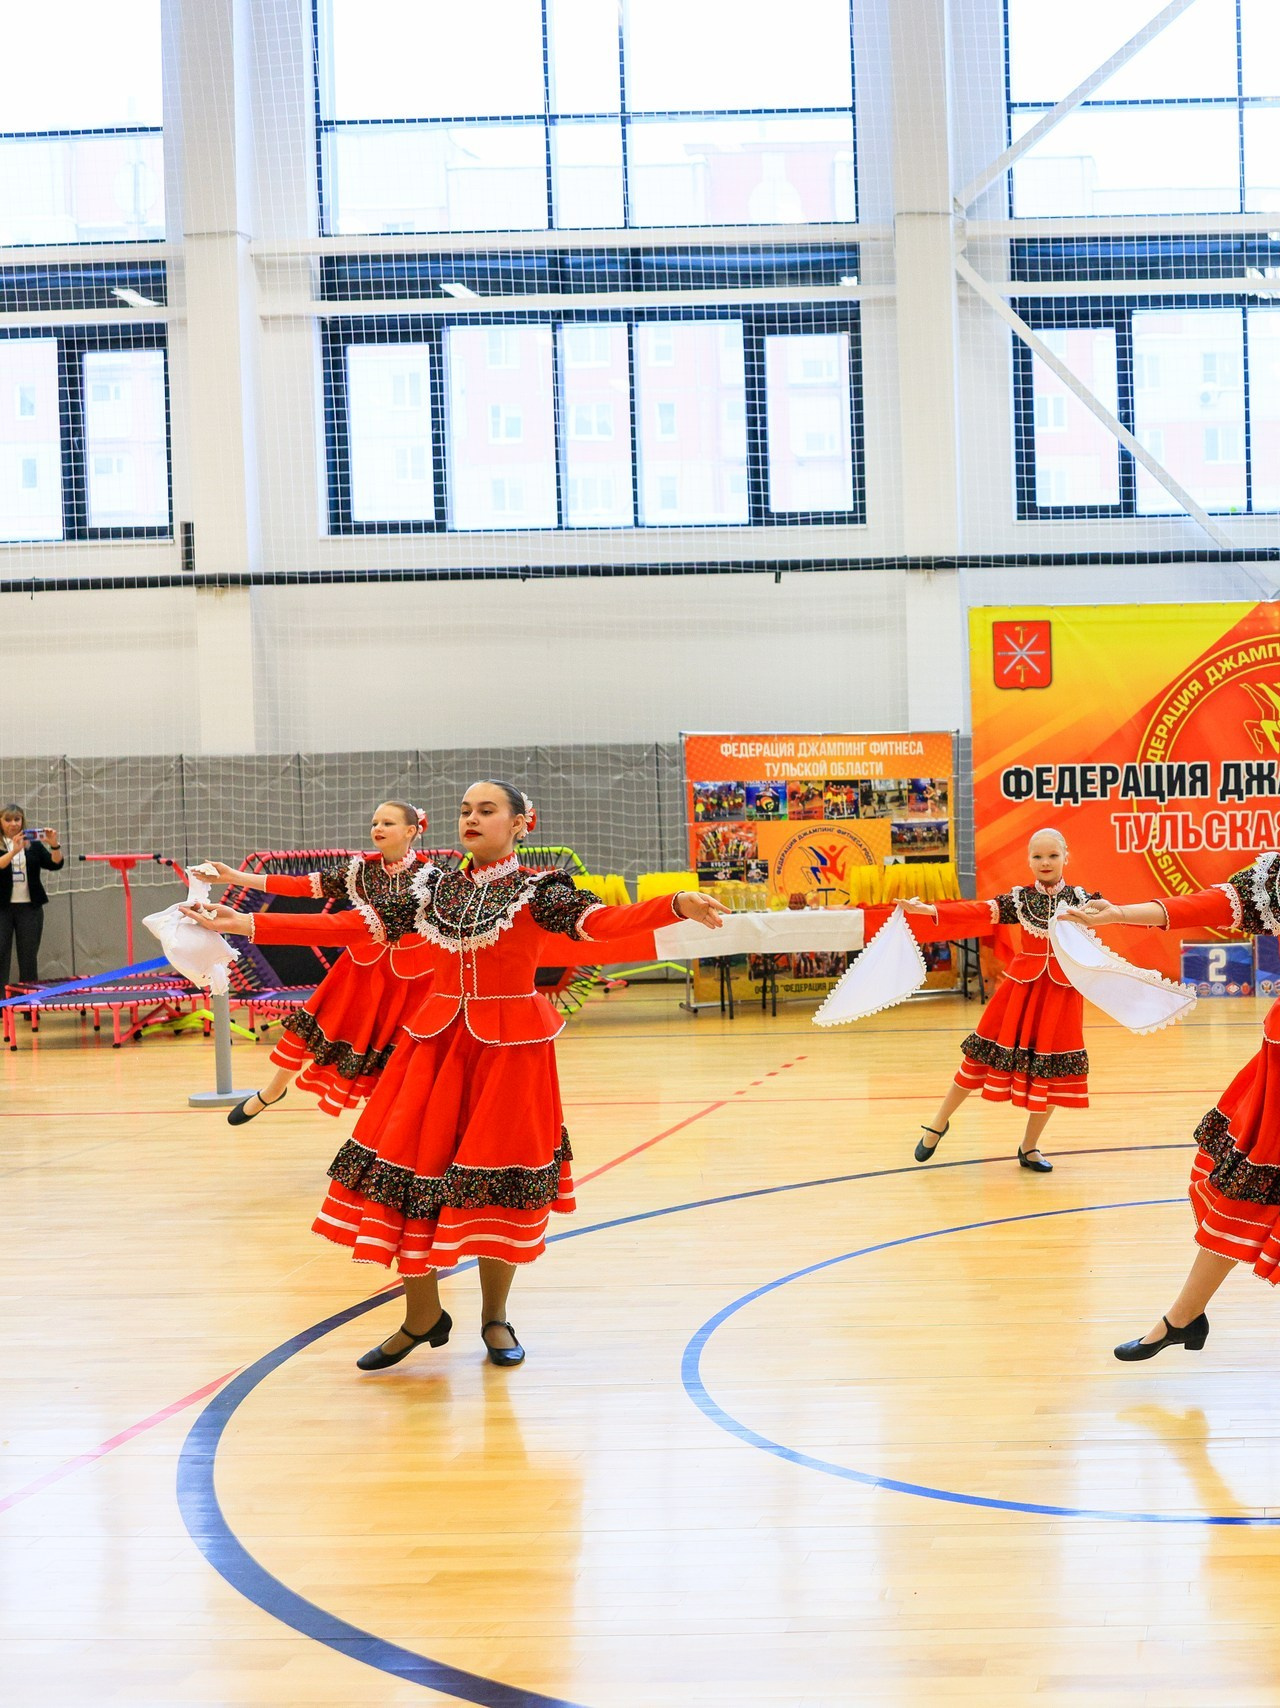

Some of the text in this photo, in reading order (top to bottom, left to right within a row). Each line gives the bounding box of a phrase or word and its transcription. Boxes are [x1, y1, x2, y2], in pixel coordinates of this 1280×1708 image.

[1146, 679, 1204, 763] ДЕРАЦИЯ
[720, 740, 924, 758] ФЕДЕРАЦИЯ ДЖАМПИНГ ФИТНЕСА
[764, 760, 883, 777] ТУЛЬСКОЙ ОБЛАСТИ
[1001, 762, 1210, 805] ФЕДЕРАЦИЯ
[1208, 948, 1227, 982] 2
